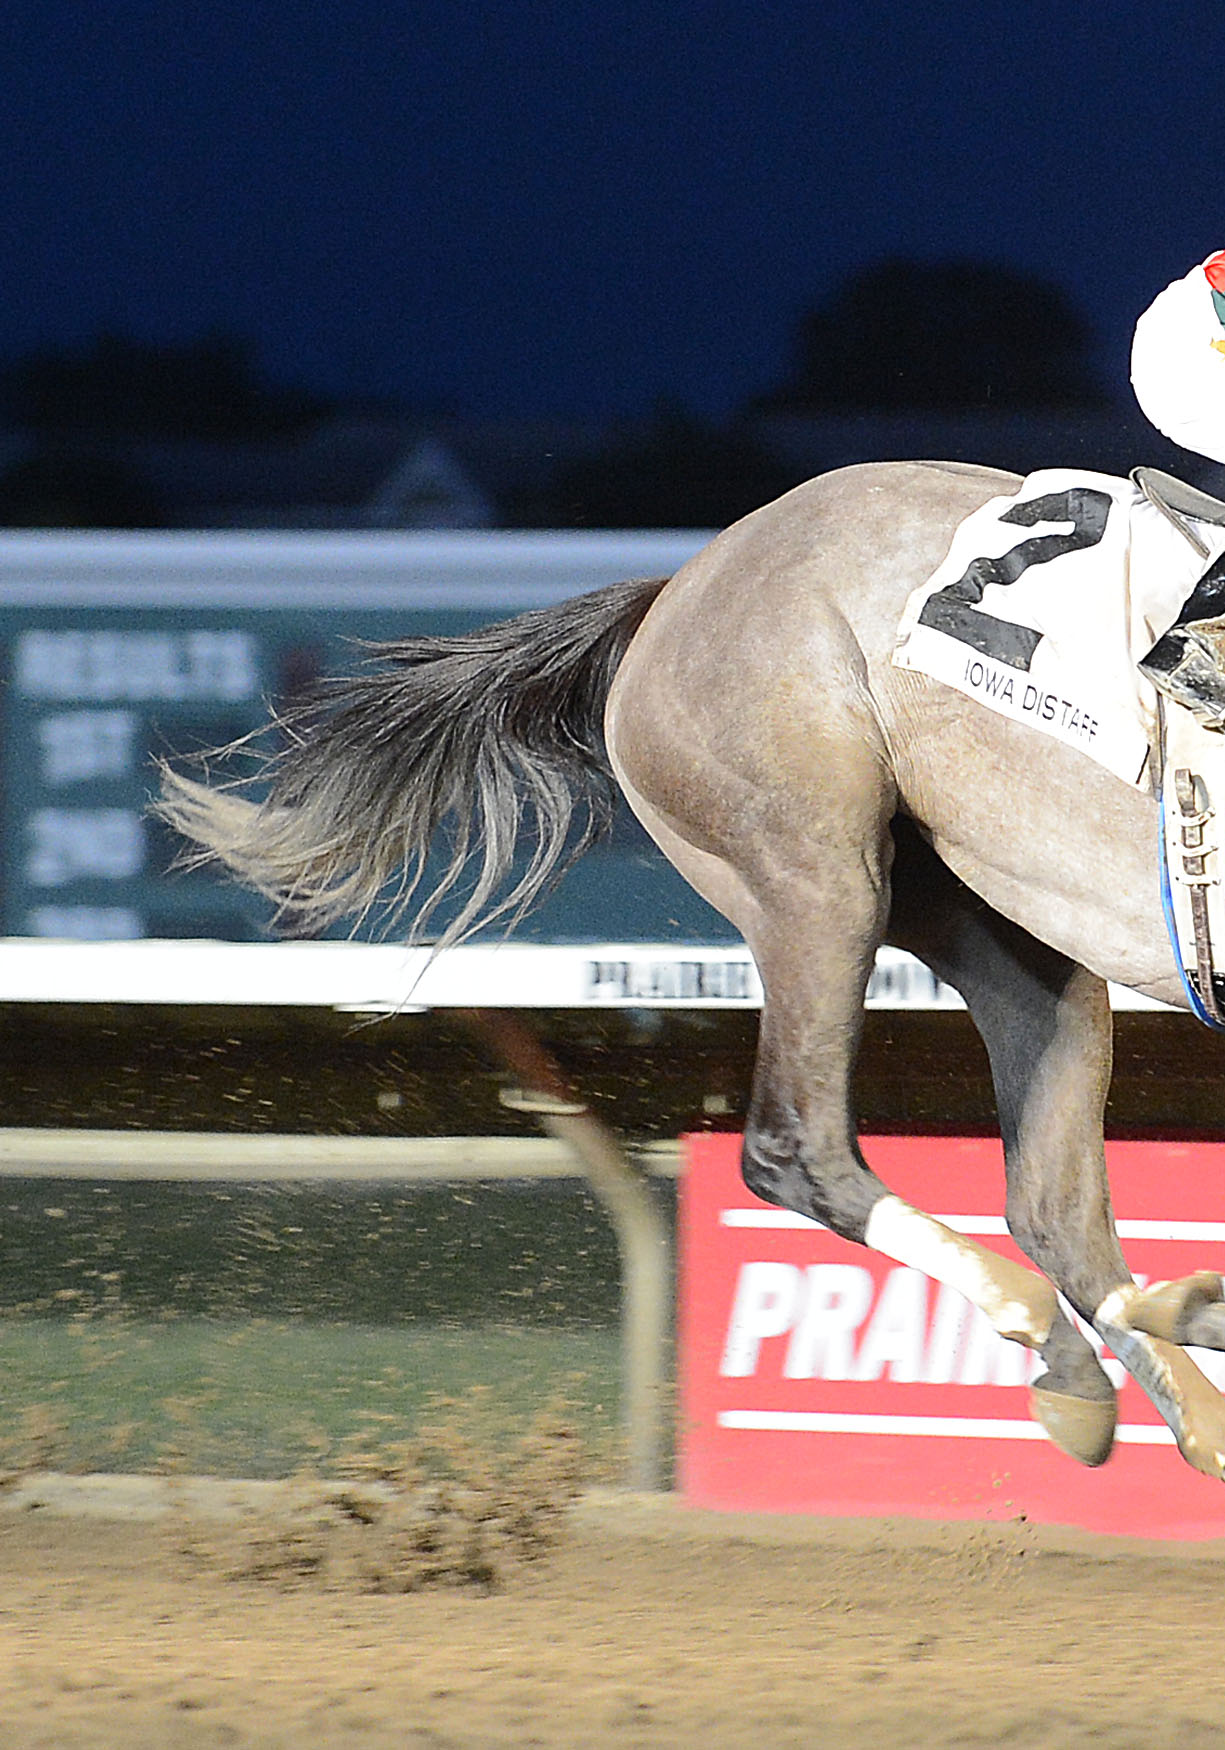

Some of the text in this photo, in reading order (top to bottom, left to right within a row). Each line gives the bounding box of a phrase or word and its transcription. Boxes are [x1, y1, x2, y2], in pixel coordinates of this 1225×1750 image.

[917, 487, 1113, 673] 2
[964, 659, 1099, 743] IOWA DISTAFF
